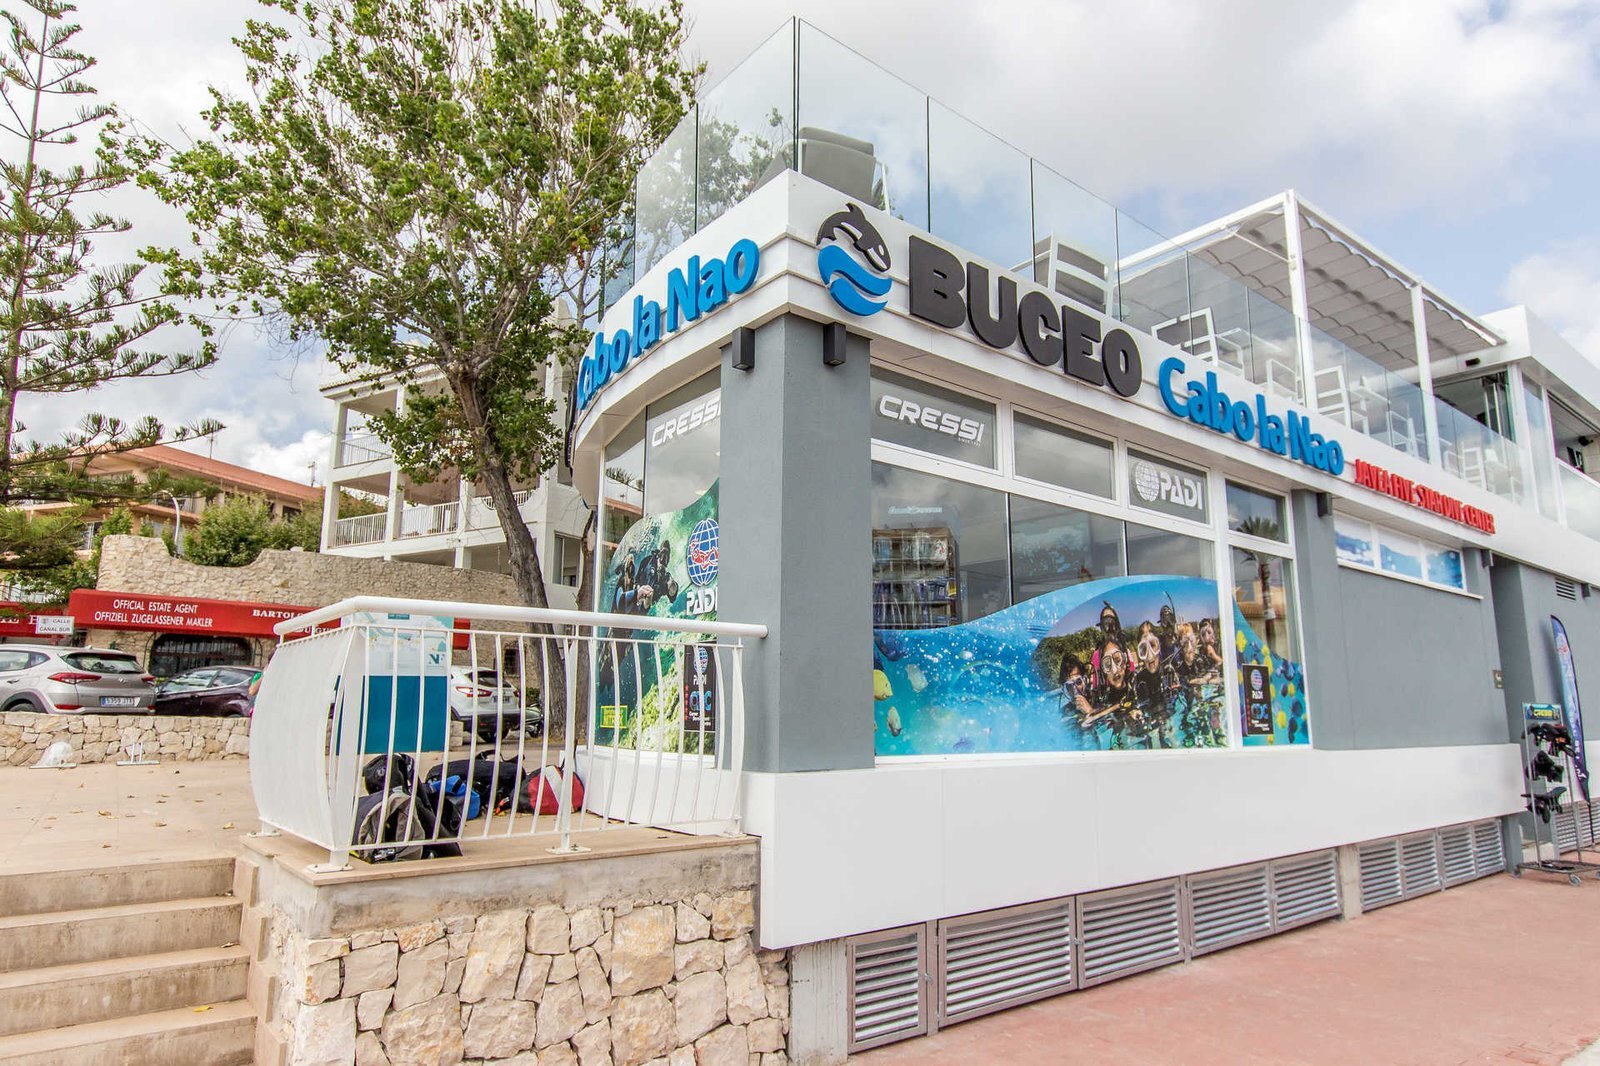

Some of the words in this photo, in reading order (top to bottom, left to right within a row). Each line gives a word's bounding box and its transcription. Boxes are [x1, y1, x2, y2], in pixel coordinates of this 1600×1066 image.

[577, 328, 630, 410] Cabo
[632, 295, 661, 358] la
[667, 238, 760, 332] Nao
[909, 235, 1143, 398] BUCEO
[879, 395, 984, 442] CRESSI
[1159, 357, 1255, 442] Cabo
[1256, 394, 1286, 455] la
[1287, 410, 1344, 475] Nao
[1160, 471, 1203, 510] PADI
[1355, 459, 1390, 494] JAVEA
[1390, 473, 1415, 503] FIVE
[1462, 504, 1496, 534] CENTER
[94, 611, 128, 623] OFFIZIELL
[131, 613, 184, 626] ZUGELASSENER
[186, 617, 213, 627] MAKLER
[113, 599, 145, 611] OFFICIAL
[148, 602, 172, 612] ESTATE
[174, 604, 199, 614] AGENT
